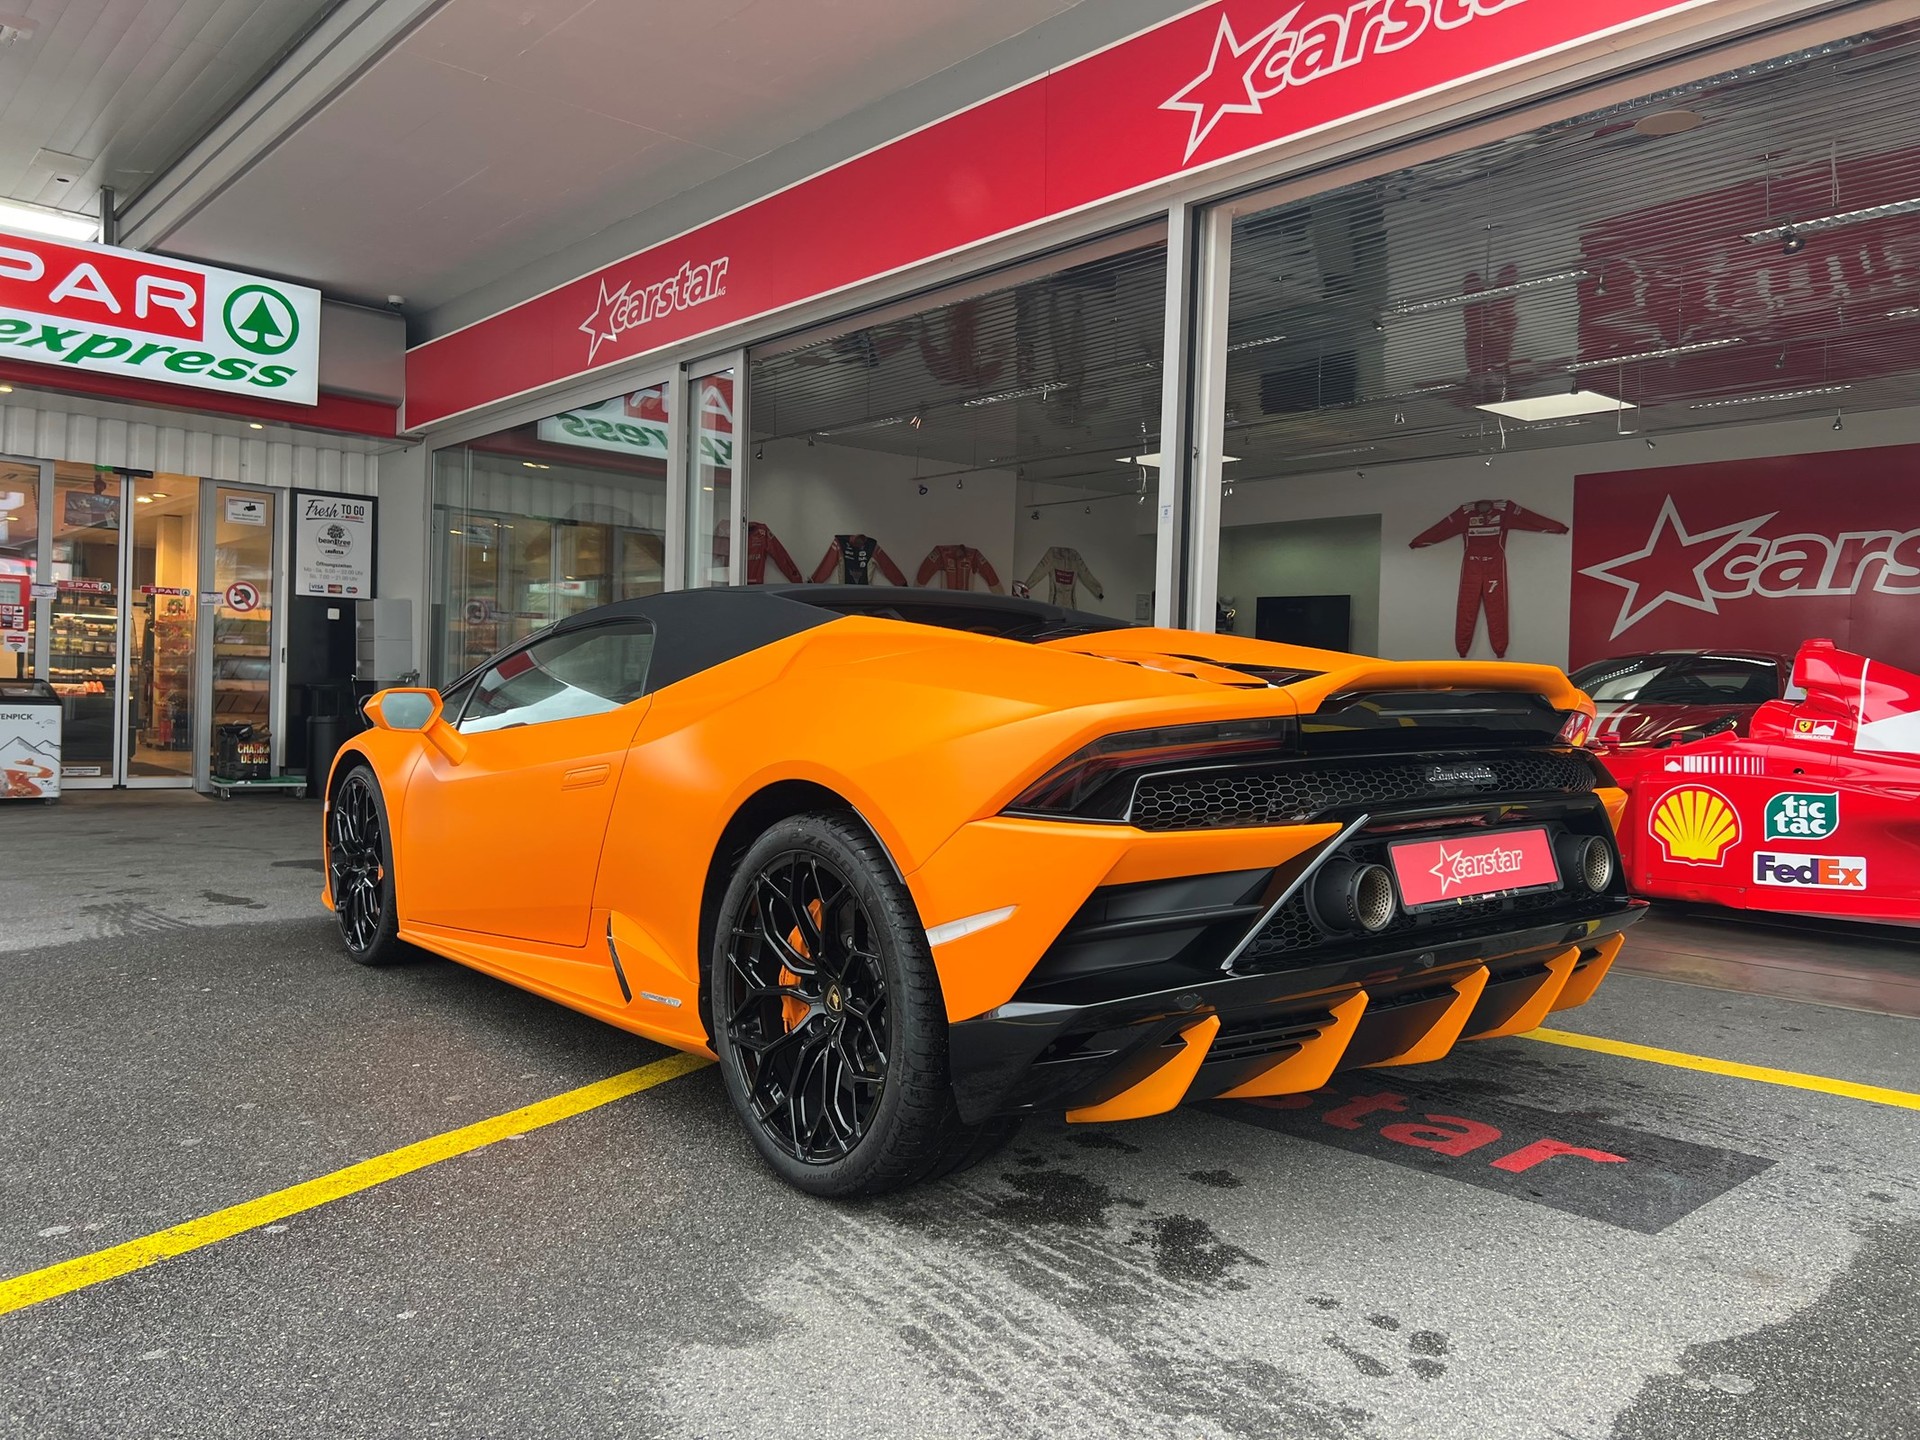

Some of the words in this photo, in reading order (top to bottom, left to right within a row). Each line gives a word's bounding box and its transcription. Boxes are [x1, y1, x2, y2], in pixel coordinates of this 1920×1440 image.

[1244, 0, 1527, 99] cars
[612, 257, 729, 333] carstar
[717, 286, 727, 297] AG
[0, 318, 298, 388] express
[306, 499, 339, 517] Fresh
[341, 503, 352, 515] TO
[353, 505, 365, 516] GO
[67, 581, 99, 589] SPAR
[150, 587, 180, 595] SPAR
[1488, 580, 1498, 593] 7
[241, 753, 252, 764] DE
[1429, 766, 1492, 782] Lamborghini
[1781, 797, 1827, 819] tic
[1773, 810, 1827, 835] tac
[1453, 847, 1522, 879] carstar
[1757, 855, 1864, 887] FedEx
